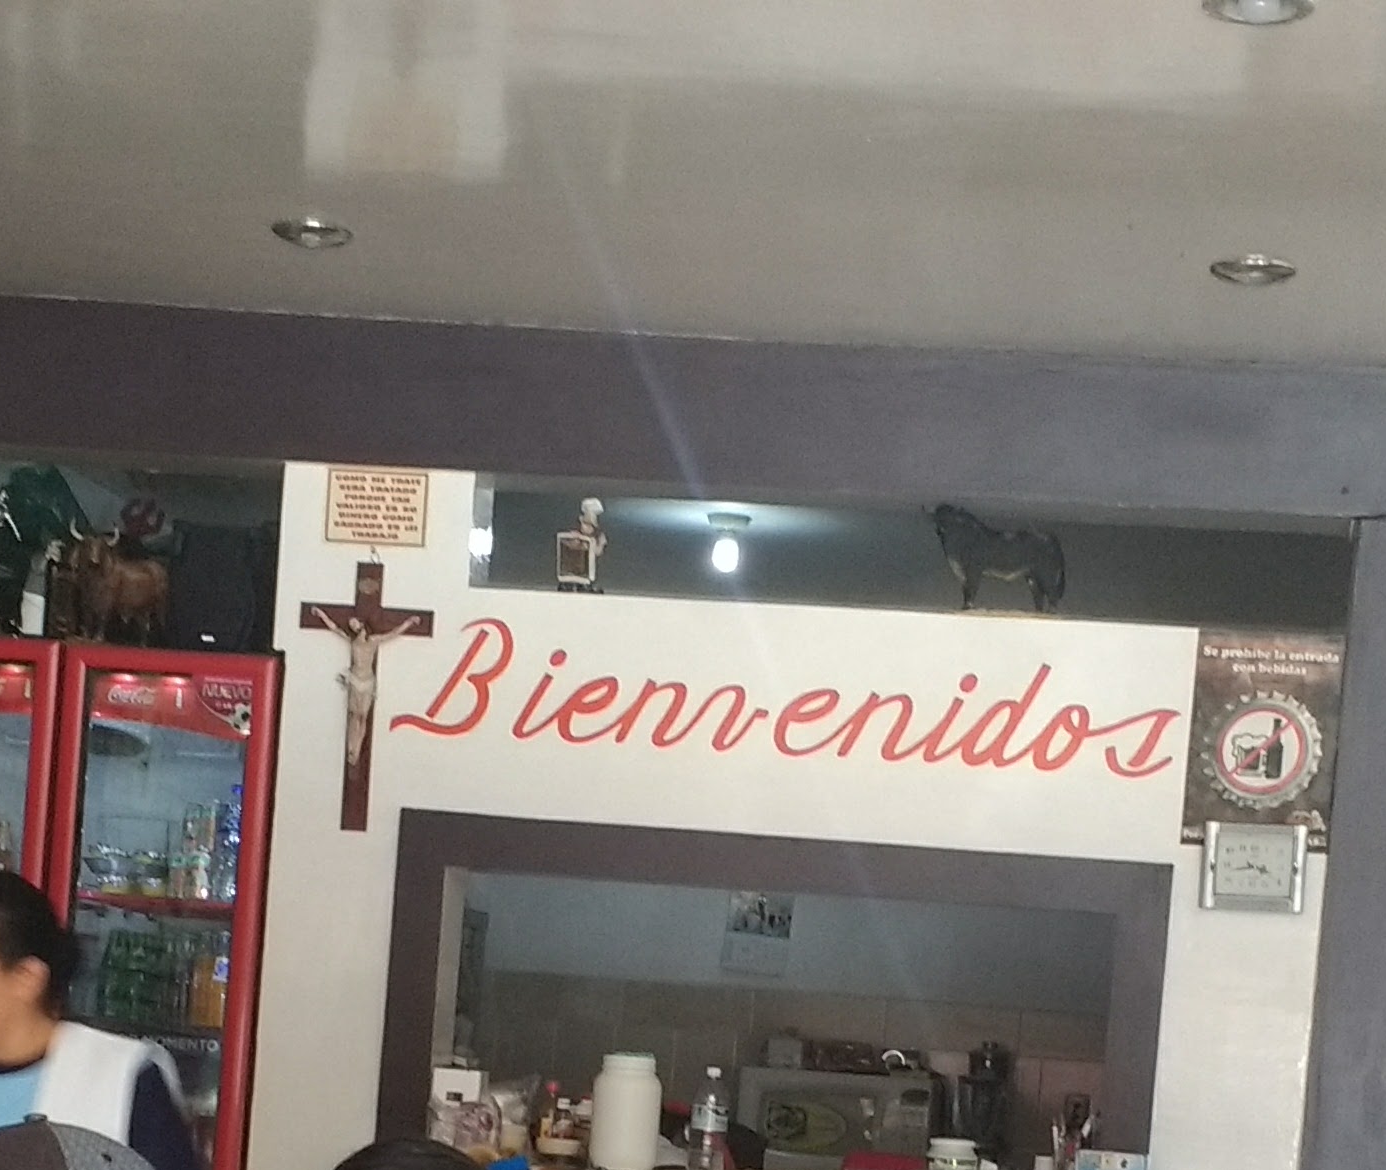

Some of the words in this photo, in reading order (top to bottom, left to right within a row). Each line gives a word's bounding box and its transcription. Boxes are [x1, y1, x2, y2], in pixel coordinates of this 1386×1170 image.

[1203, 645, 1219, 657] Se
[1220, 648, 1271, 660] prohibe
[1274, 649, 1286, 660] la
[1288, 651, 1340, 664] entrada
[1232, 663, 1256, 673] con
[1258, 662, 1307, 675] bebidas
[201, 682, 252, 700] NUEVO
[388, 616, 1182, 779] Bienvenidos
